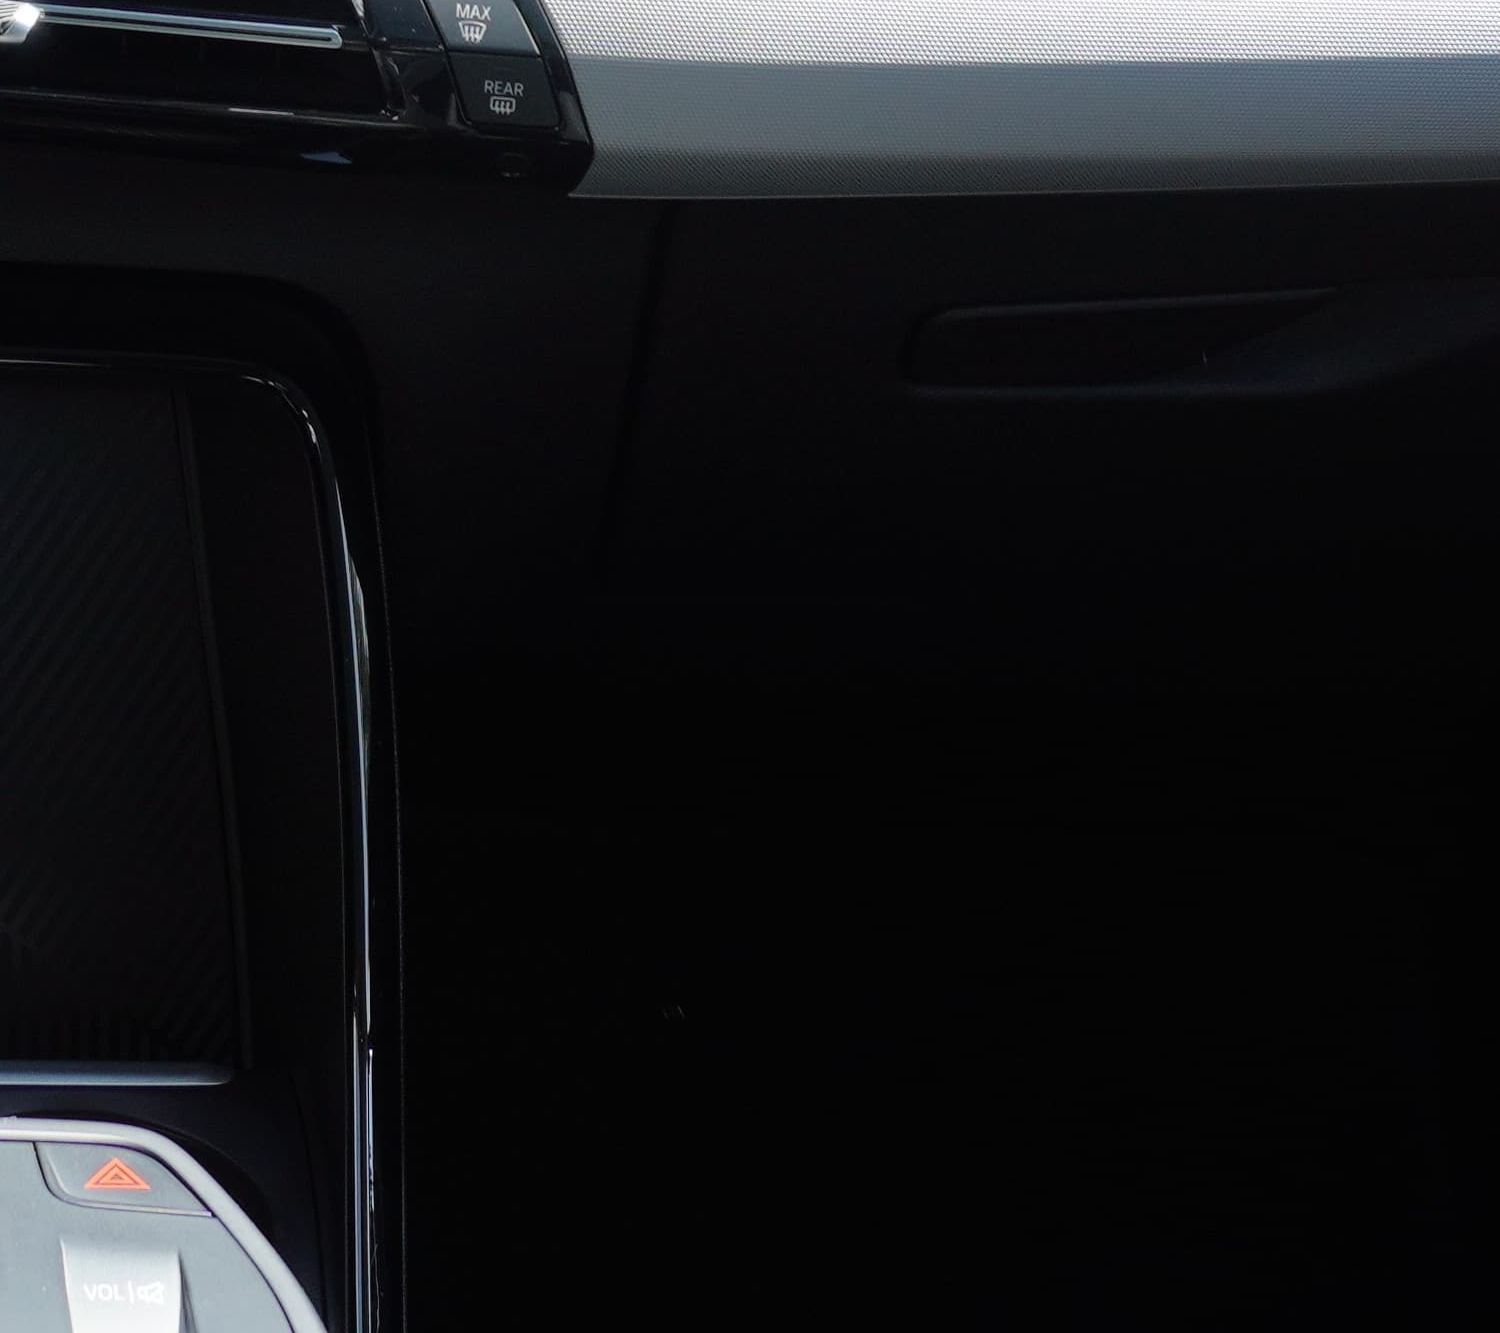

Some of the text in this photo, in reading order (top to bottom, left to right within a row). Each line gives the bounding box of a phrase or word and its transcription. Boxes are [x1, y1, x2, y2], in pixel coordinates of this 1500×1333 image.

[455, 3, 492, 21] MAX
[484, 79, 524, 98] REAR
[83, 1283, 126, 1302] VOL
